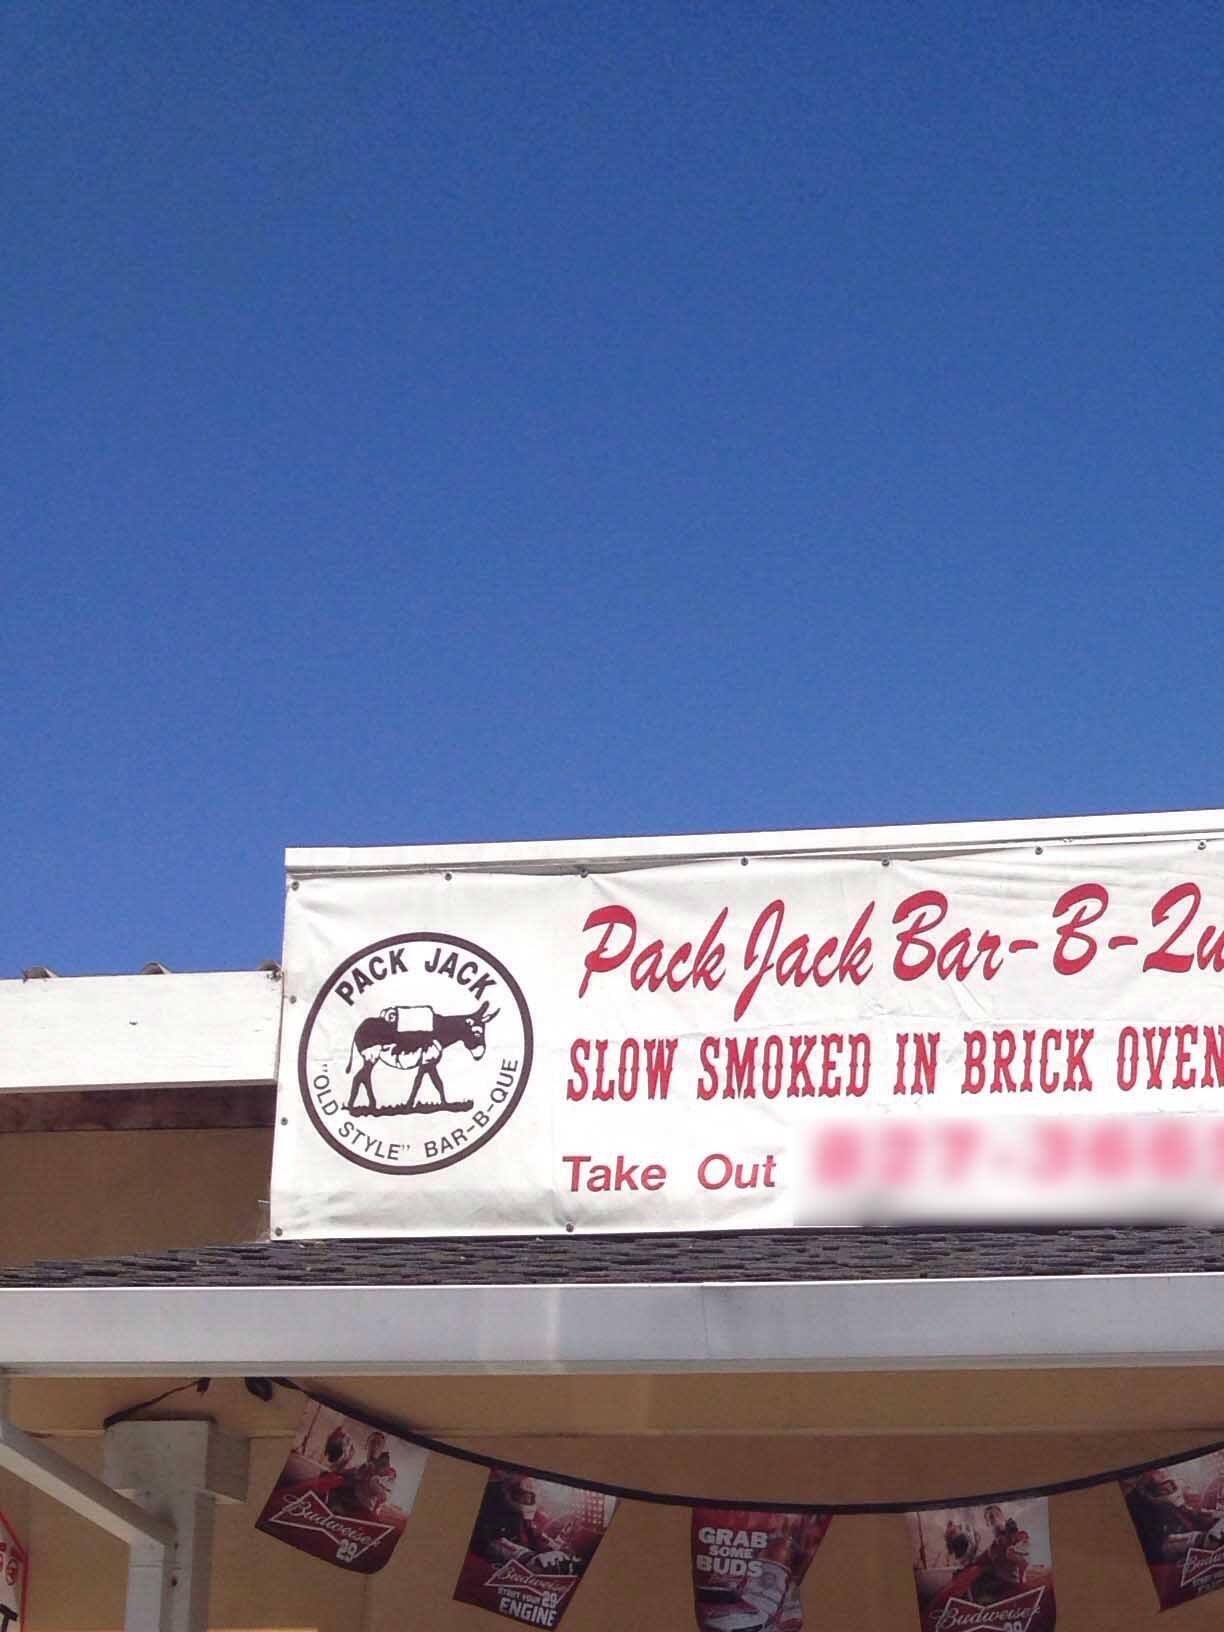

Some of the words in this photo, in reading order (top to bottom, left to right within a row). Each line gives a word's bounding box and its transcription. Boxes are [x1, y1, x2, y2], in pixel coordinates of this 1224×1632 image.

[335, 948, 408, 1006] PACK
[424, 948, 497, 1000] JACK
[580, 903, 729, 998] Pack
[734, 898, 875, 1022] Jack
[567, 1038, 680, 1102] SLOW
[696, 1032, 872, 1101] SMOKED
[893, 1031, 941, 1096] IN
[962, 1028, 1097, 1095] BRICK
[424, 1059, 518, 1158] BAR-B-QUE
[564, 1154, 668, 1192] Take
[698, 1152, 776, 1190] Out
[284, 1494, 381, 1547] Budweiser
[698, 1527, 768, 1548] GRAB
[696, 1554, 763, 1577] BUDS
[709, 1545, 753, 1558] SOME
[929, 1607, 1041, 1631] Budweiser
